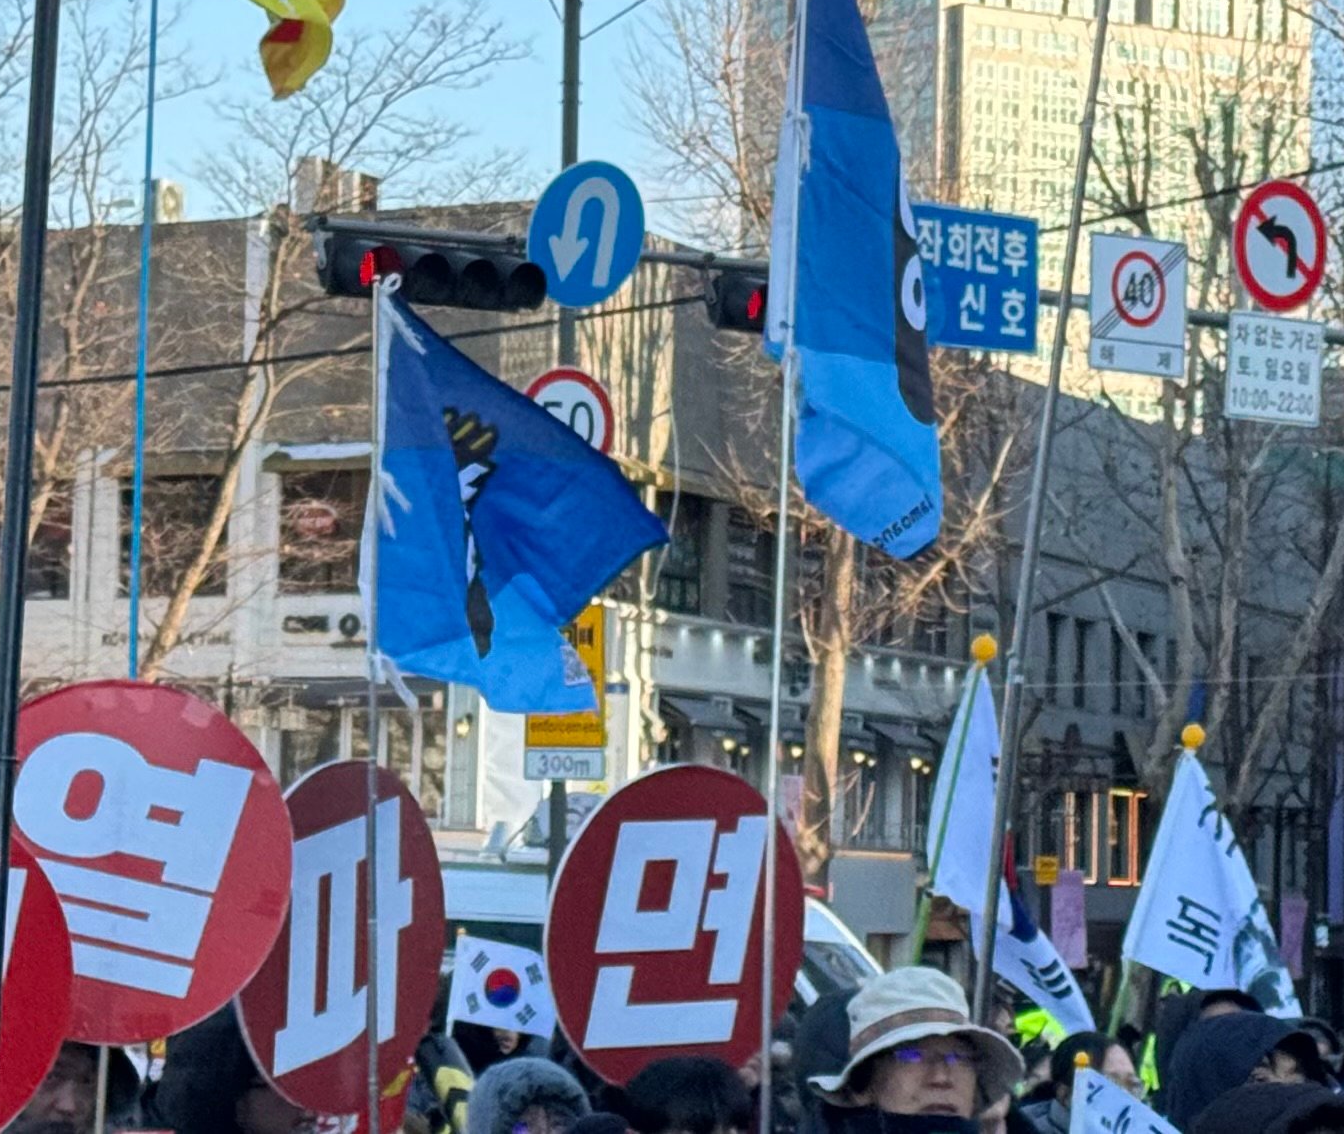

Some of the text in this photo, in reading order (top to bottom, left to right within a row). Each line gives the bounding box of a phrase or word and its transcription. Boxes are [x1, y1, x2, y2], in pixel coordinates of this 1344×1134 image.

[915, 218, 1029, 278] 좌회전후
[1122, 271, 1155, 309] 40
[537, 754, 591, 776] 300m
[13, 732, 254, 1000] 열
[273, 795, 414, 1077] 파
[583, 815, 768, 1050] 면
